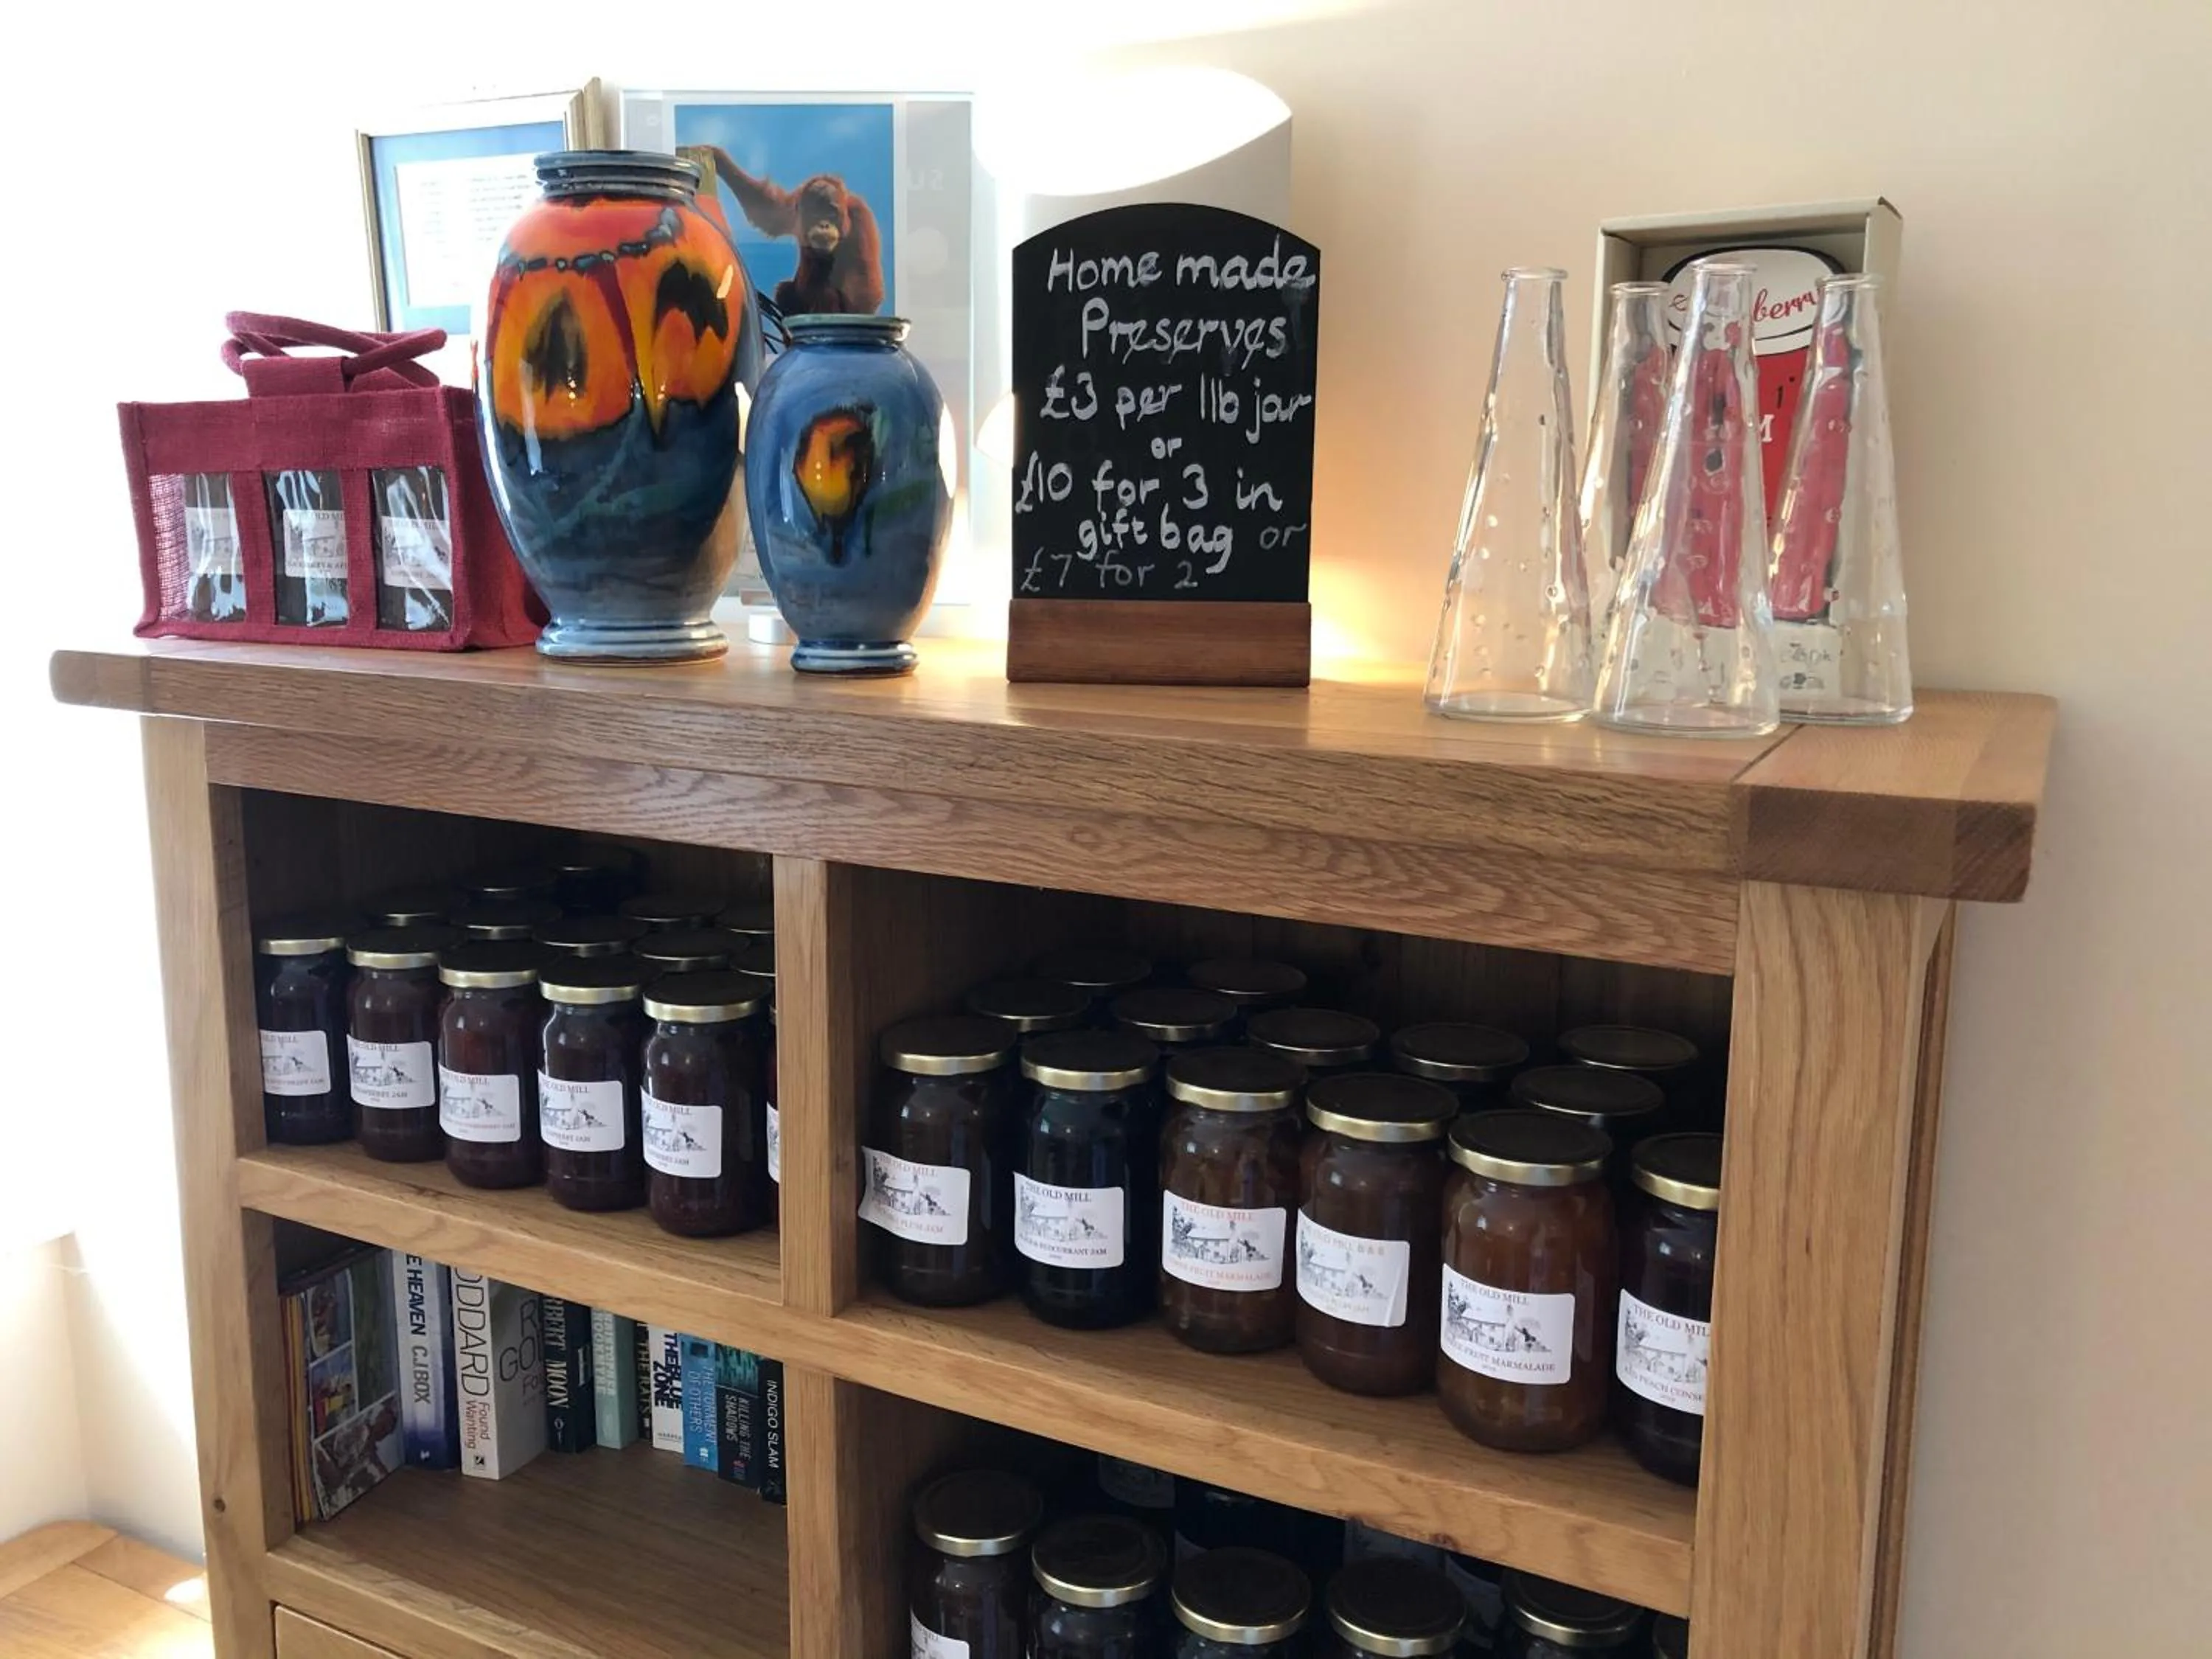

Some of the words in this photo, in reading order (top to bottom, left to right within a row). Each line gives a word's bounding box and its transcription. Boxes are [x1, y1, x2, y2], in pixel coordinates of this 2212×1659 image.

[1048, 248, 1162, 292] Home
[1176, 233, 1315, 290] made
[1082, 298, 1287, 369] Preserves
[1040, 365, 1098, 420] £3
[1116, 384, 1182, 431] per
[1246, 377, 1312, 443] jar
[1151, 437, 1182, 459] or
[1015, 451, 1073, 514] £10
[1092, 459, 1160, 512] for
[1183, 463, 1208, 509] 3
[1237, 467, 1283, 511] in
[1077, 508, 1148, 560] gift
[1160, 502, 1233, 574] bag
[1259, 524, 1307, 549] or
[1095, 549, 1155, 588] for
[1175, 561, 1198, 588] 2
[1064, 1192, 1091, 1203] MILL
[407, 1269, 426, 1336] HEAVEN
[1479, 1287, 1500, 1300] OLD
[1502, 1293, 1530, 1306] MILL
[1634, 1304, 1654, 1321] THE
[1655, 1314, 1680, 1331] OLD
[664, 1332, 680, 1366] THE
[1492, 1356, 1557, 1372] MARMALADE
[545, 1359, 570, 1410] MOON
[653, 1360, 669, 1407] ZONE
[766, 1380, 779, 1429] INDIGO
[465, 1400, 476, 1450] Wanting
[479, 1402, 491, 1441] Found
[689, 1389, 703, 1434] OTHERS
[768, 1430, 779, 1469] SLAM
